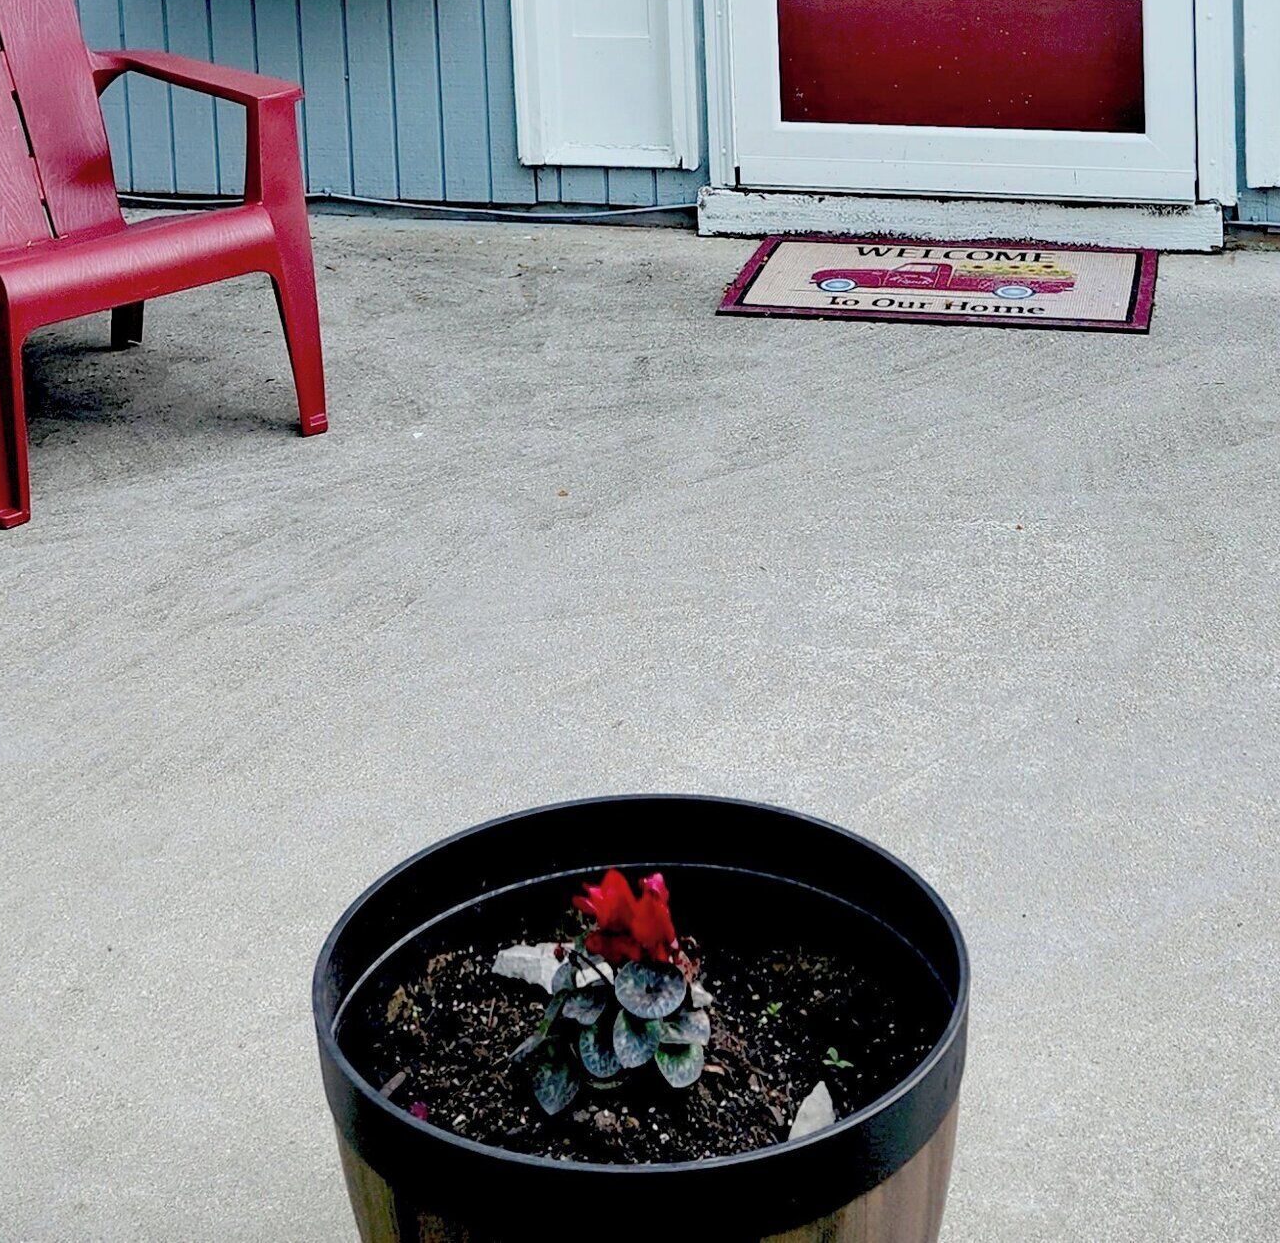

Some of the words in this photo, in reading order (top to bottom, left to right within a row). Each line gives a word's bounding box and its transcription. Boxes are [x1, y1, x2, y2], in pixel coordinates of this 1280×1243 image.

[856, 246, 1056, 263] WELCOME
[825, 295, 860, 307] To
[872, 297, 933, 310] Our
[944, 300, 1046, 315] Home
